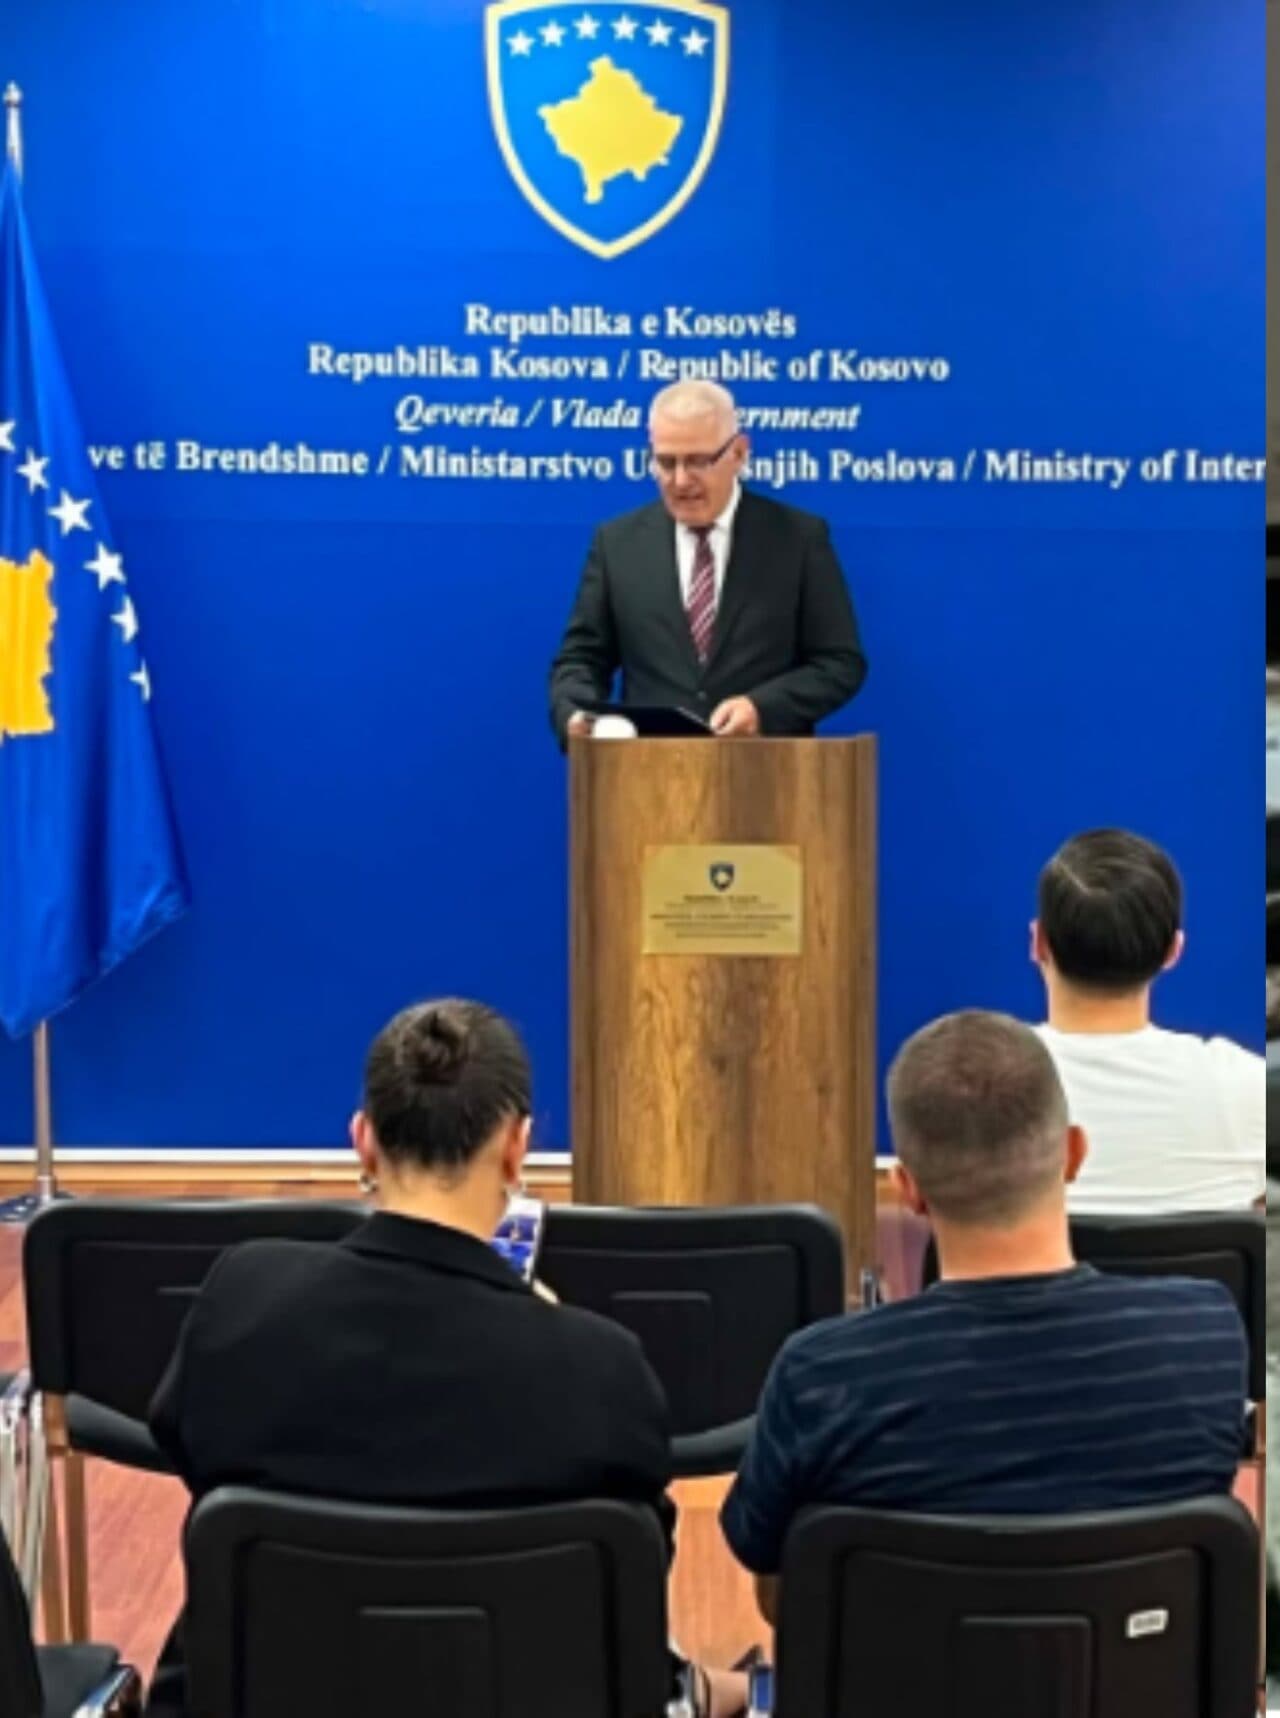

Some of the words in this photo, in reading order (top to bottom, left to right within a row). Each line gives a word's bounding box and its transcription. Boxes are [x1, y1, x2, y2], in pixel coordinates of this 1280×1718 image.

[466, 303, 632, 344] Republika
[641, 314, 659, 337] e
[665, 306, 796, 337] Kosovës
[309, 343, 480, 383] Republika
[490, 347, 609, 379] Kosova
[617, 353, 628, 378] /
[638, 348, 779, 384] Republic
[787, 350, 823, 381] of
[829, 350, 950, 381] Kosovo
[395, 395, 519, 433] Qeveria
[525, 400, 542, 426] /
[552, 398, 641, 428] Vlada
[734, 402, 862, 430] ernment
[135, 441, 166, 470] të
[176, 440, 369, 475] Brendshme
[378, 448, 389, 473] /
[401, 445, 613, 479] Ministarstvo
[830, 449, 955, 481] Poslova
[964, 452, 975, 478] /
[986, 449, 1130, 489] Ministry
[1140, 449, 1177, 481] of
